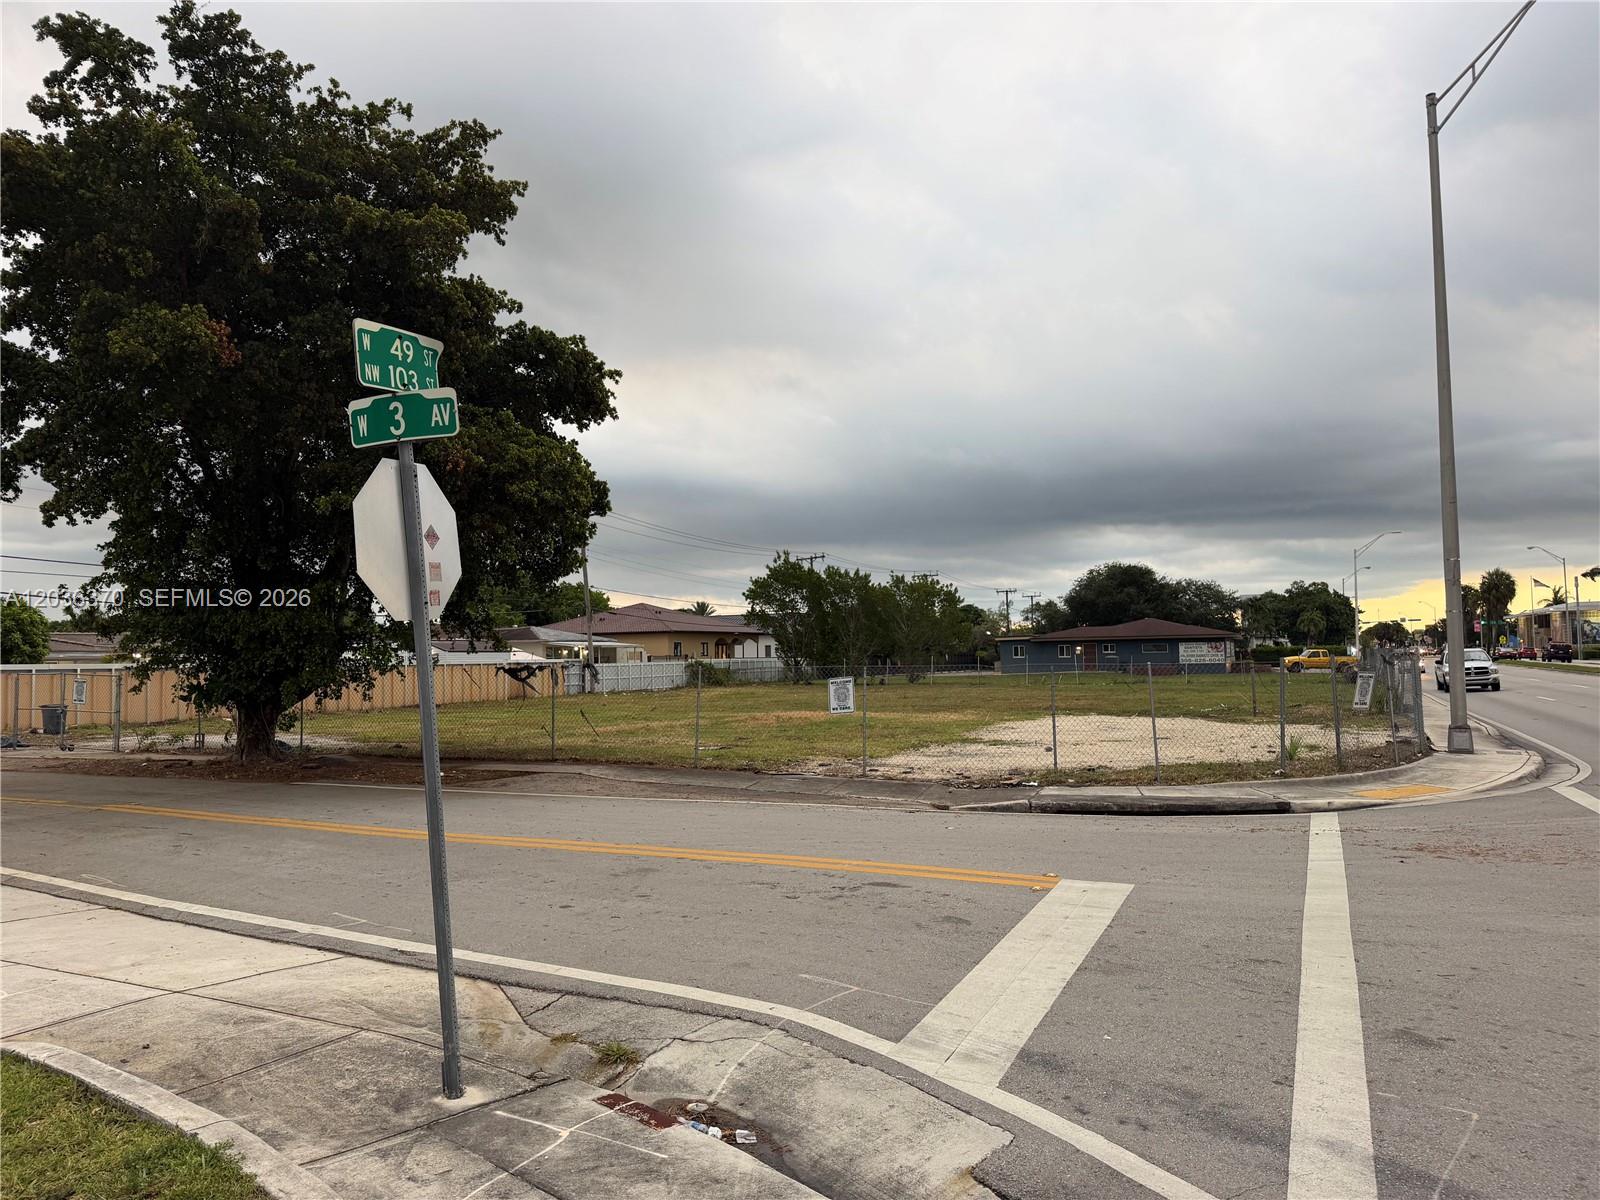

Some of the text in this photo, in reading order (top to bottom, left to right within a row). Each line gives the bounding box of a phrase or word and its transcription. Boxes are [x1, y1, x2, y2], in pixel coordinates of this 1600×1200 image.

[362, 332, 434, 367] W 49 ST
[364, 363, 435, 391] NW 103 ST
[357, 401, 451, 438] W 3 AV
